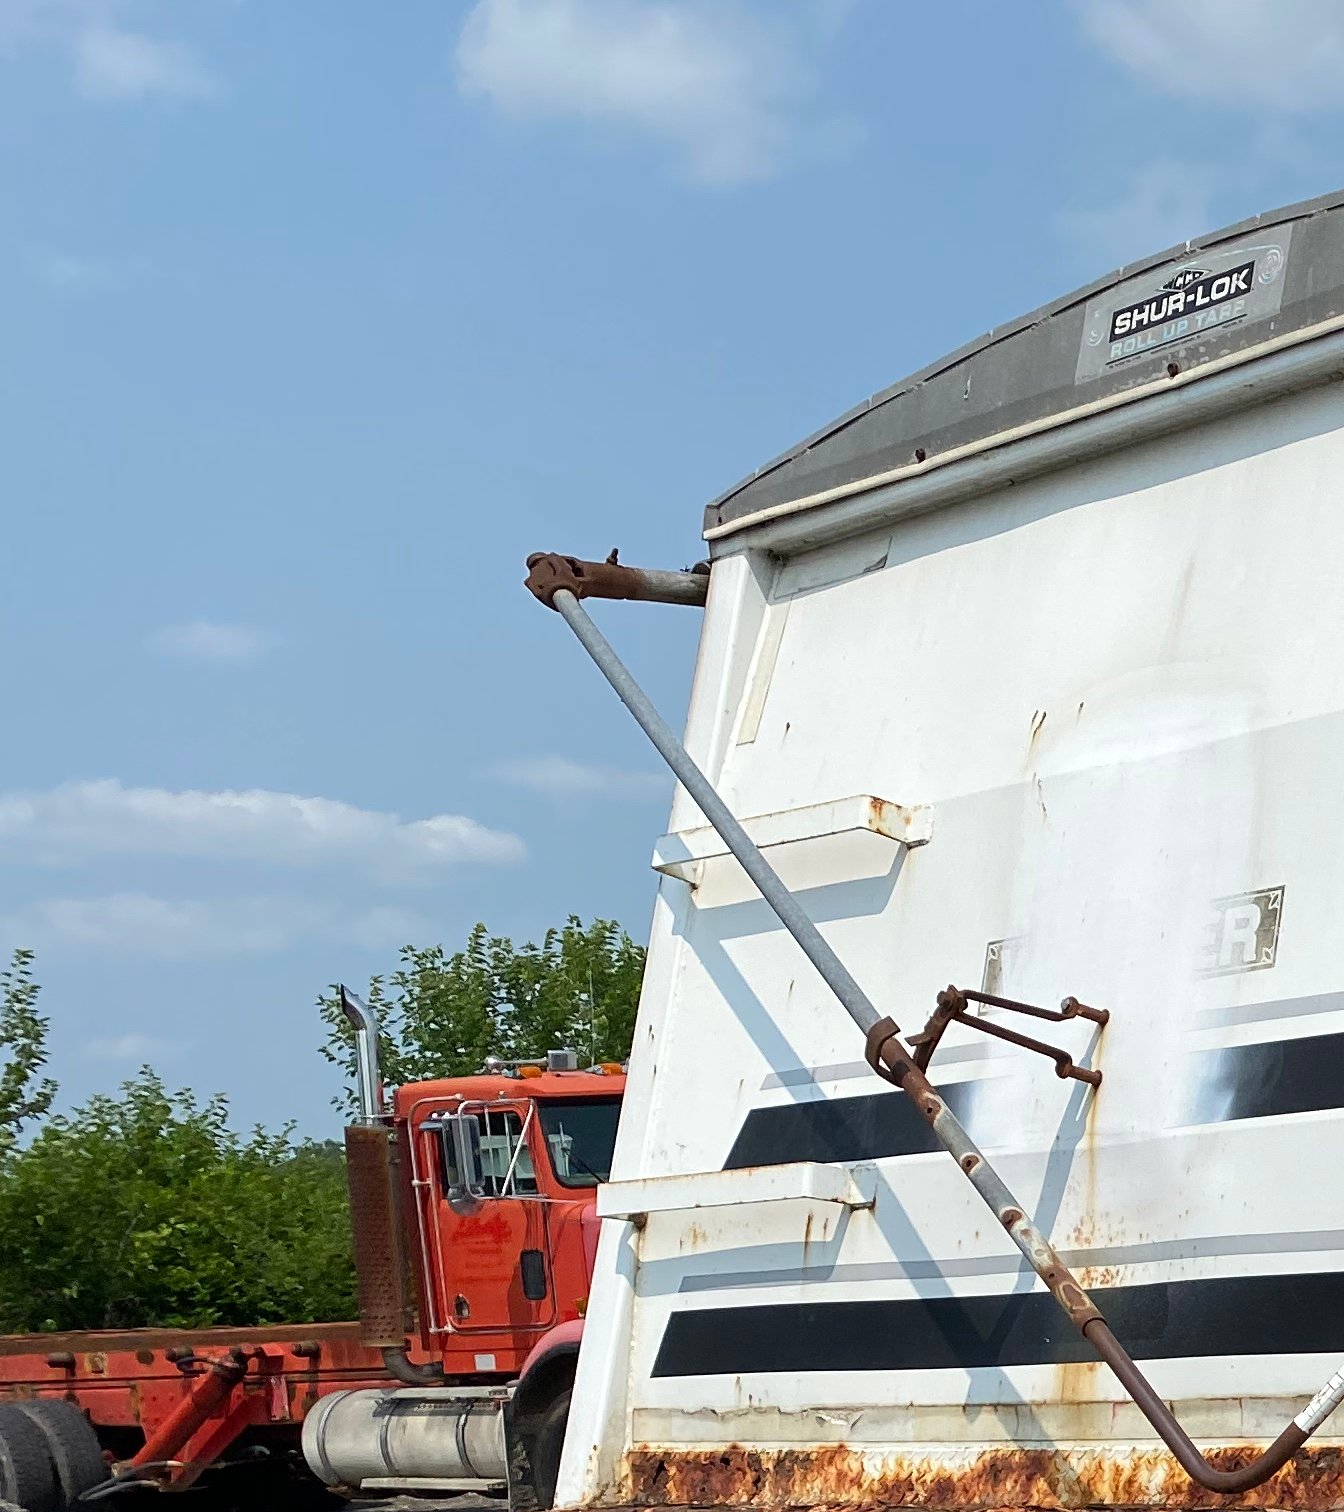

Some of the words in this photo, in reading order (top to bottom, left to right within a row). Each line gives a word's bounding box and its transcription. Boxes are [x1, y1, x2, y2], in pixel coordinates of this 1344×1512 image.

[1114, 268, 1250, 335] SHUR-LOK
[1110, 334, 1156, 360] ROLL
[1163, 319, 1189, 341] UP
